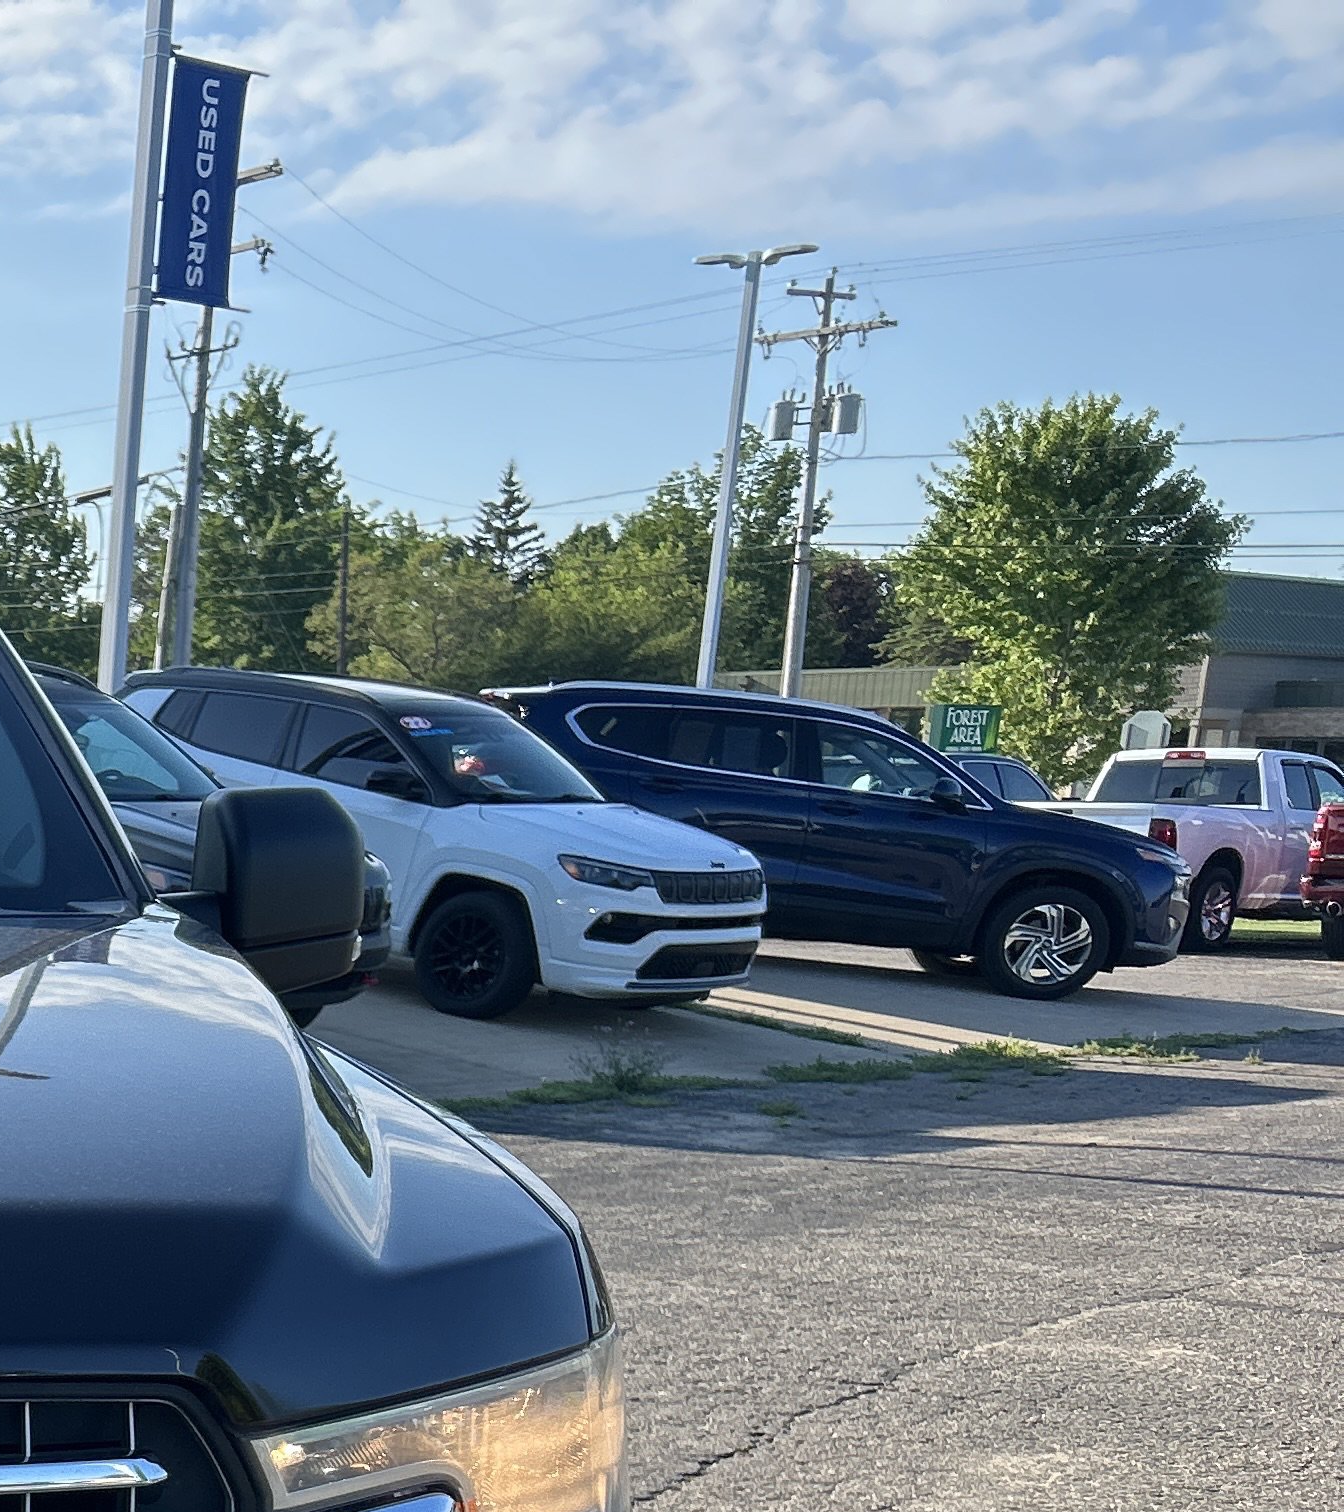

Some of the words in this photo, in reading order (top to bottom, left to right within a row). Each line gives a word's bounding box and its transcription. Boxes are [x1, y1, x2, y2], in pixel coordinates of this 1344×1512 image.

[195, 78, 221, 178] USED
[185, 188, 211, 288] CARS
[945, 707, 990, 728] FOREST
[950, 726, 982, 745] AREA
